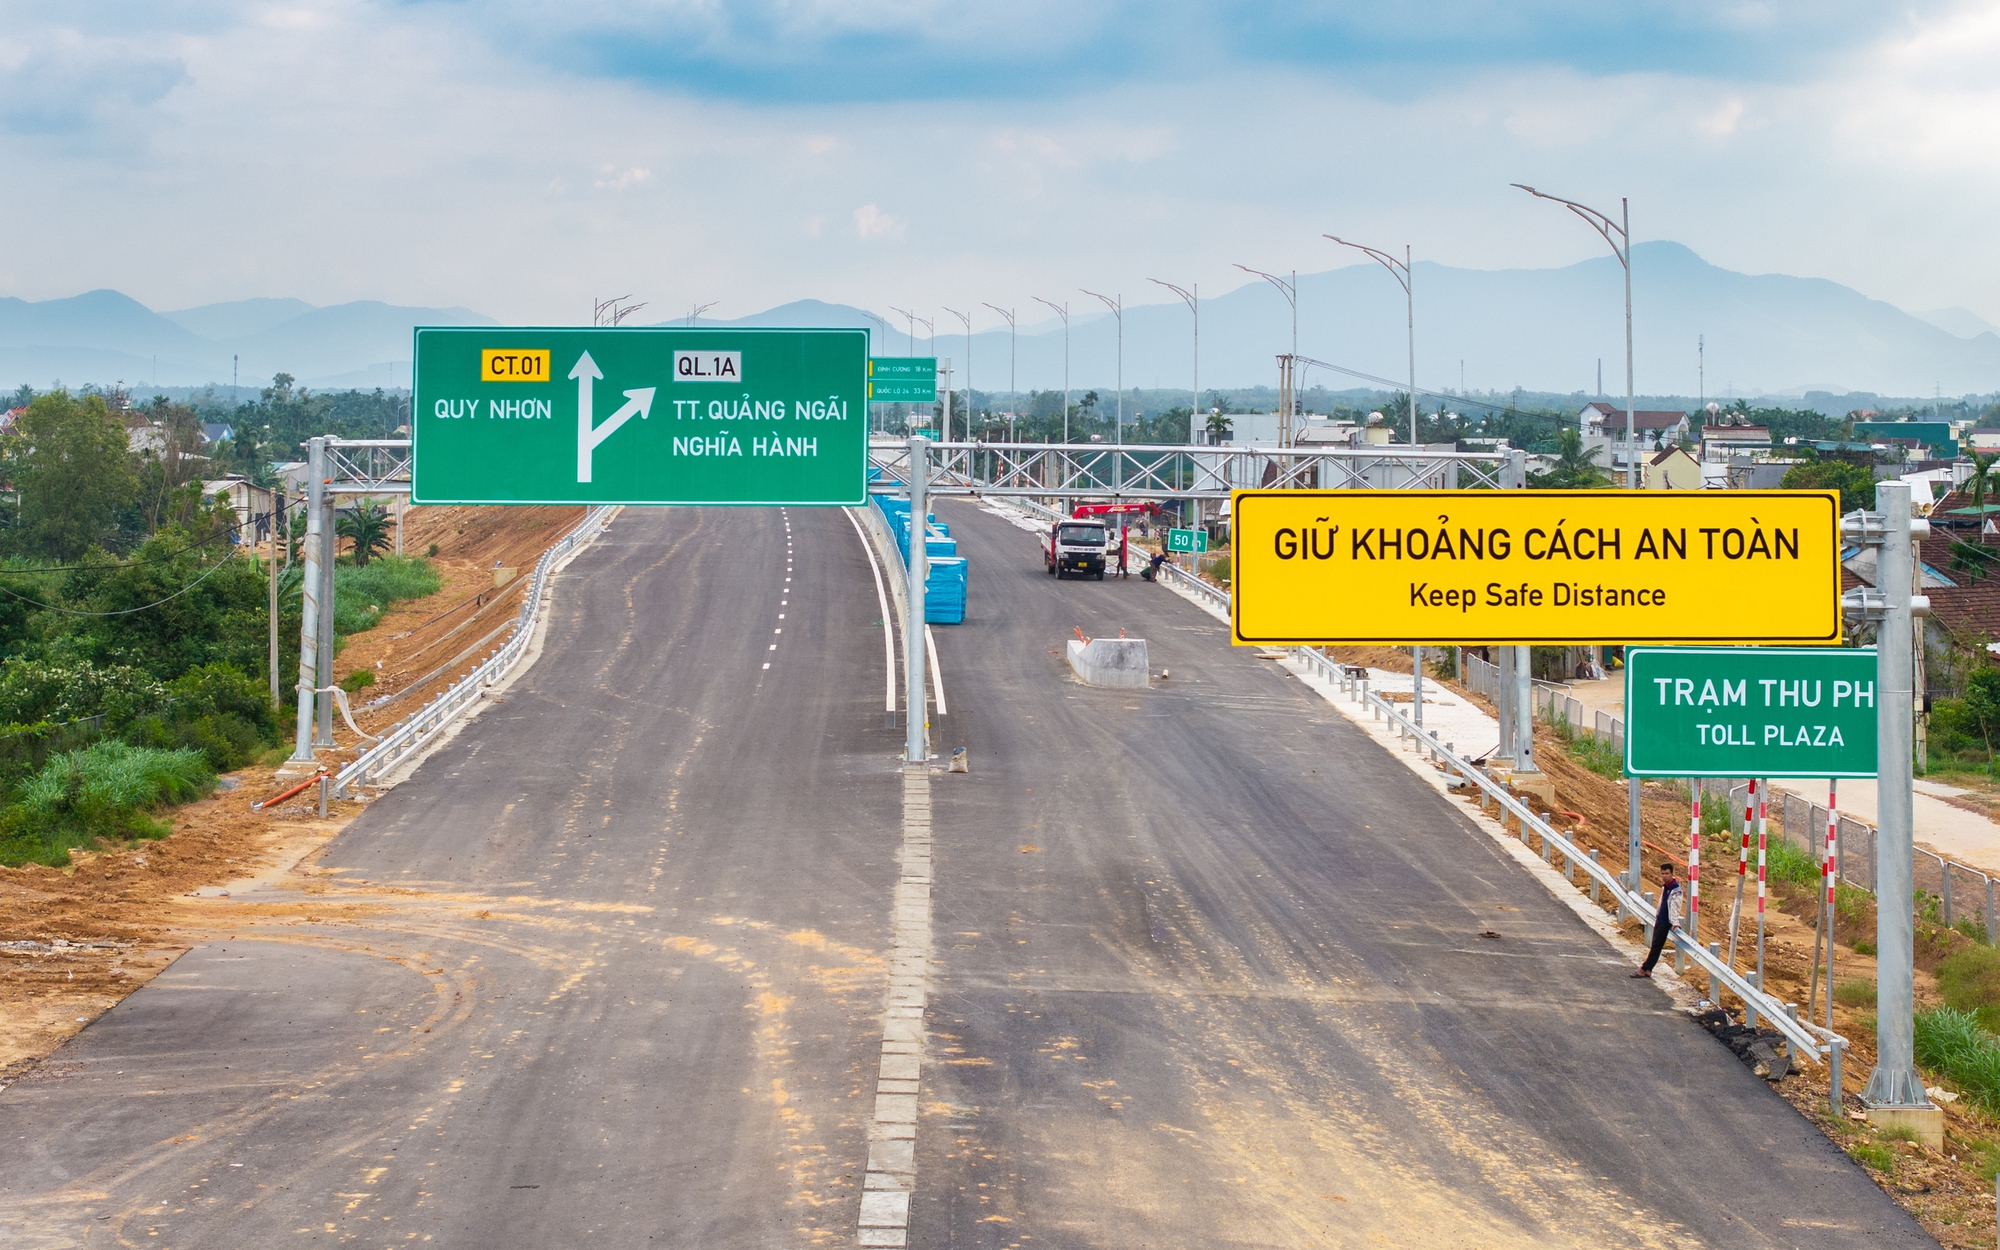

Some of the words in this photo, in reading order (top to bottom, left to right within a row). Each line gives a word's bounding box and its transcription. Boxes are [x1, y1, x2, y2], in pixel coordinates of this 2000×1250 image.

[491, 355, 541, 375] CT.01
[678, 356, 736, 377] QL.1A
[434, 398, 480, 419] QUY
[489, 397, 551, 419] NHƠN
[673, 400, 703, 420] TT.
[708, 393, 785, 420] QUẢNG
[795, 395, 847, 420] NGÃI
[673, 430, 743, 456] NGHĨA
[752, 431, 817, 457] HÀNH
[1174, 534, 1188, 546] 50
[1274, 516, 1339, 560] GIỮ
[1352, 515, 1510, 560] KHOẢNG
[1524, 518, 1620, 560] CÁCH
[1635, 528, 1687, 560] AN
[1698, 517, 1799, 560] TOÀN
[1410, 583, 1476, 613] Keep
[1485, 582, 1543, 607] Safe
[1553, 583, 1666, 607] Distance
[1653, 677, 1747, 714] TRẠM
[1758, 679, 1822, 707] THU
[1833, 680, 1875, 708] PH
[1696, 724, 1756, 746] TOLL
[1764, 725, 1845, 747] PLAZA
